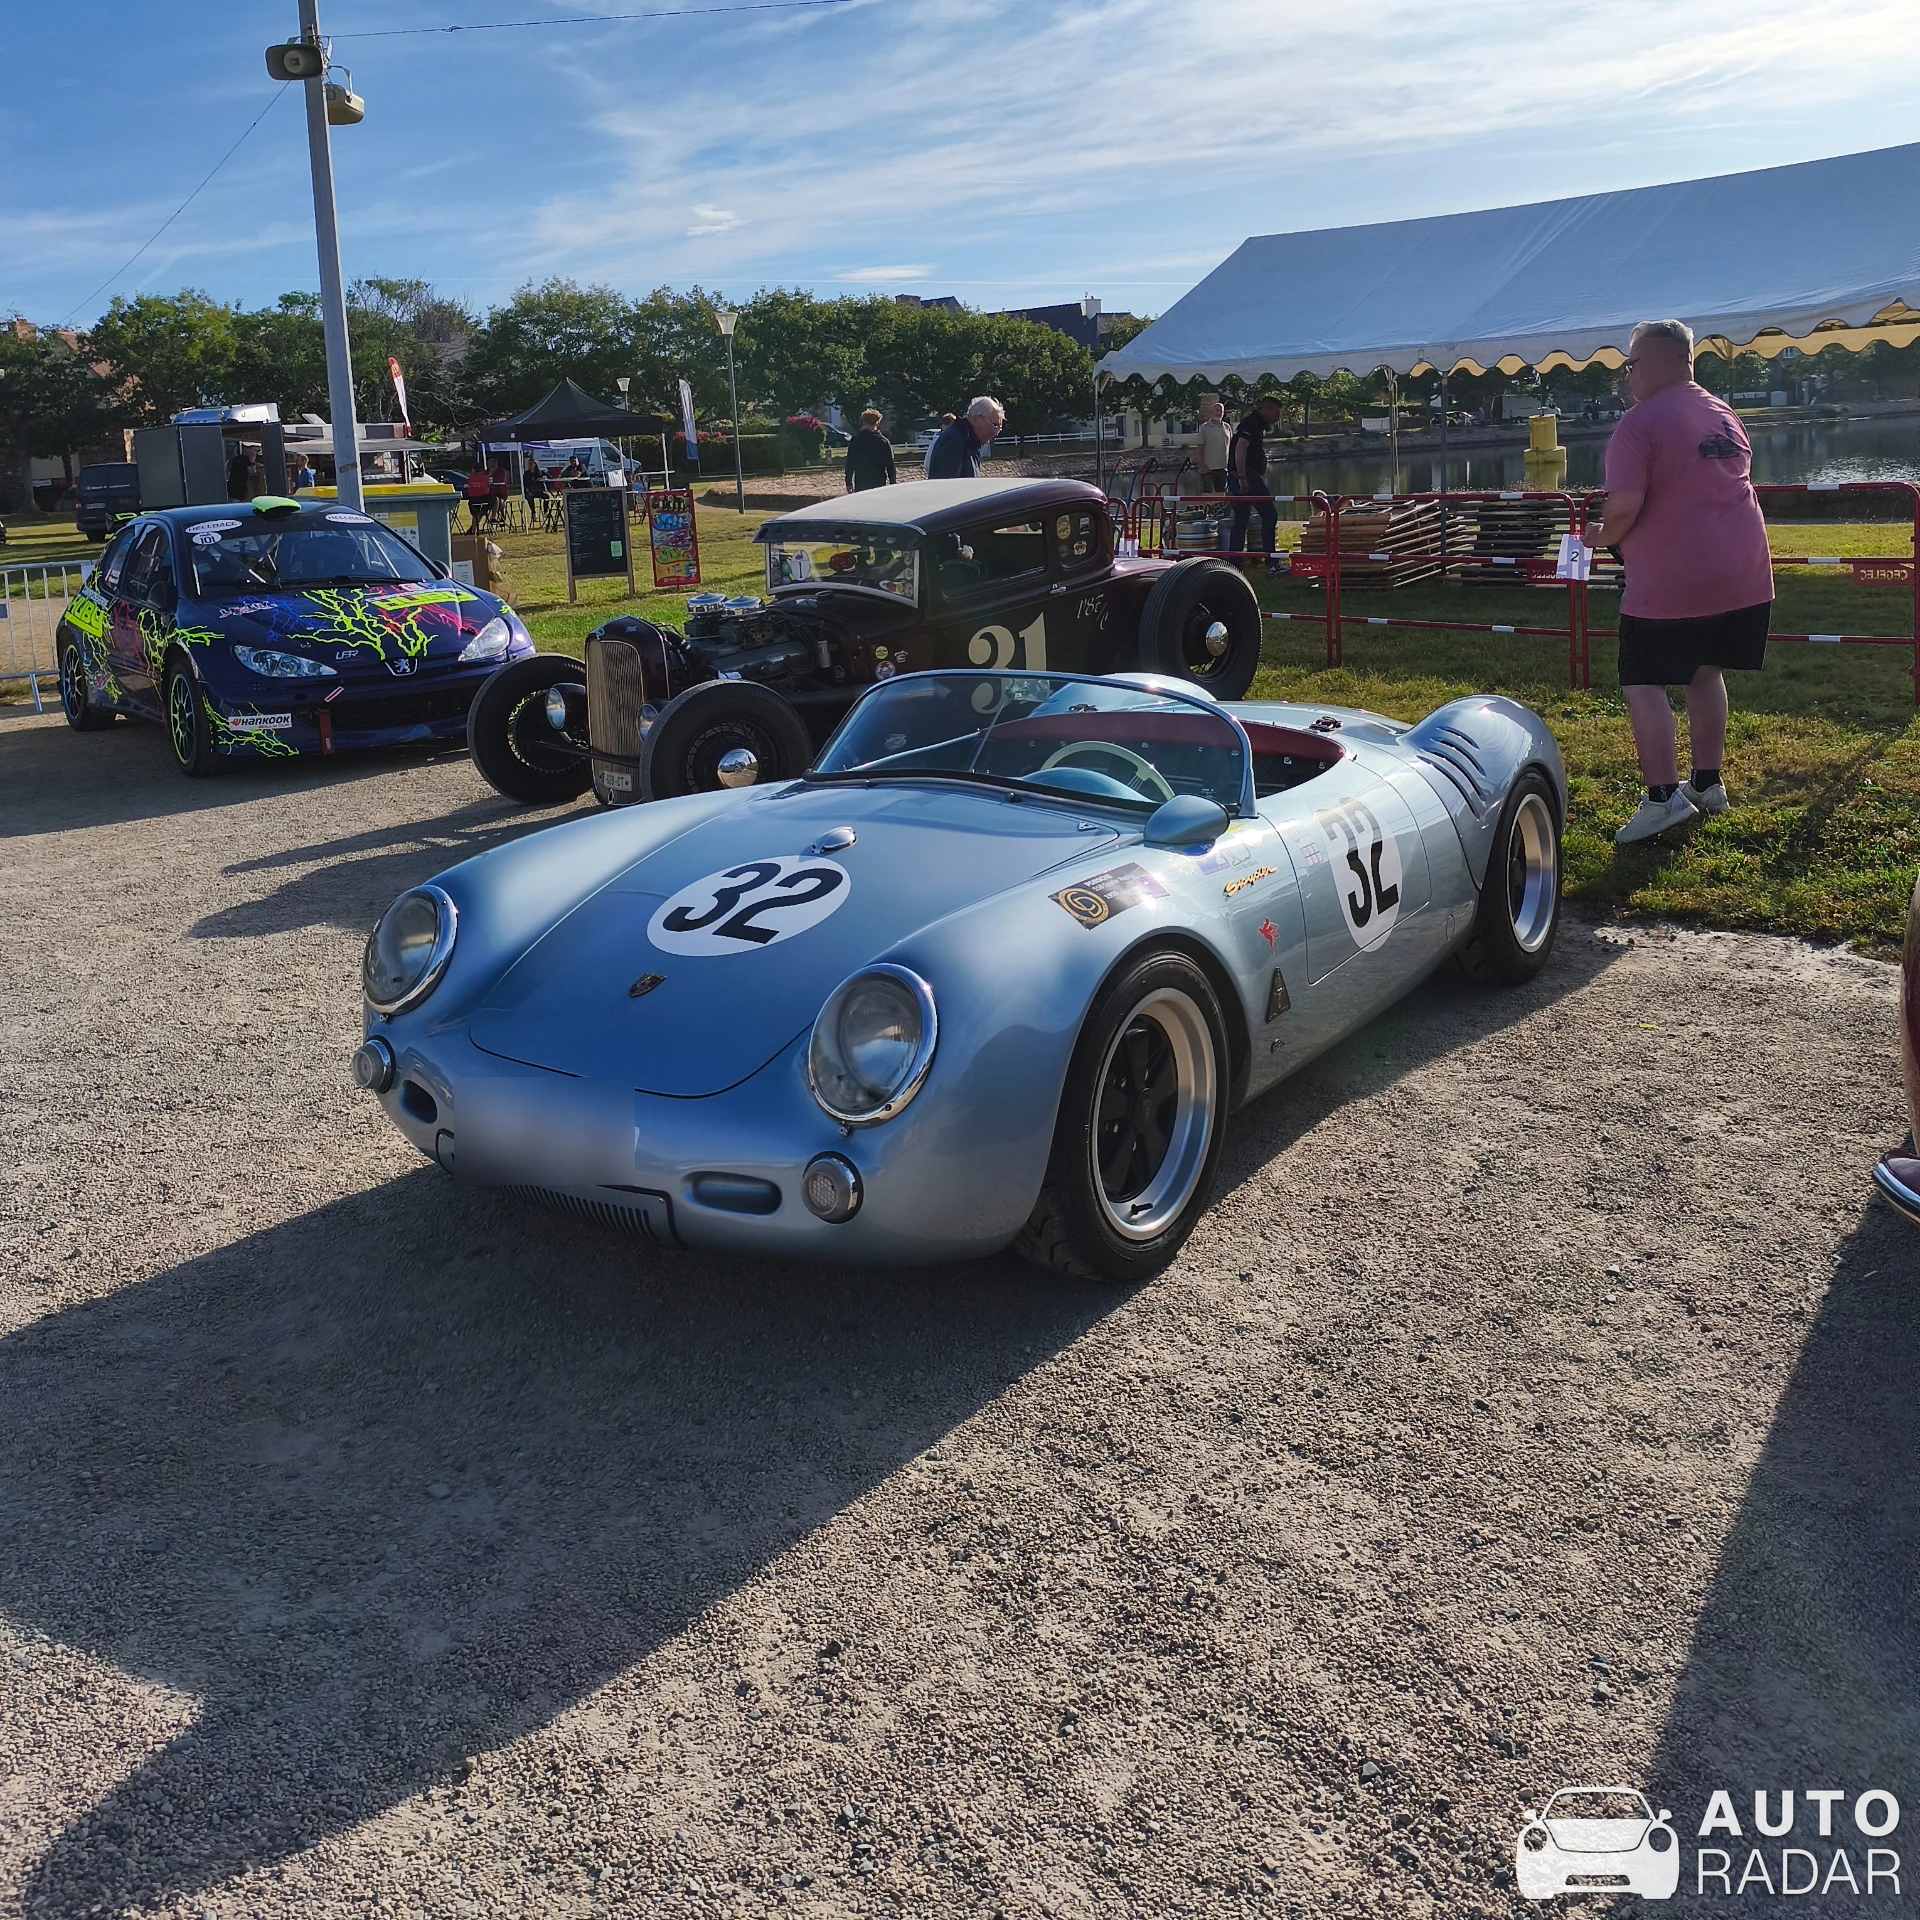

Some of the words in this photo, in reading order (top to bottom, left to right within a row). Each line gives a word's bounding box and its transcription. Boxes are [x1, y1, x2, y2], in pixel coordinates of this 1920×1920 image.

[1570, 550, 1580, 562] 2
[968, 612, 1048, 714] 31
[662, 863, 844, 944] 32
[1316, 797, 1399, 928] 32
